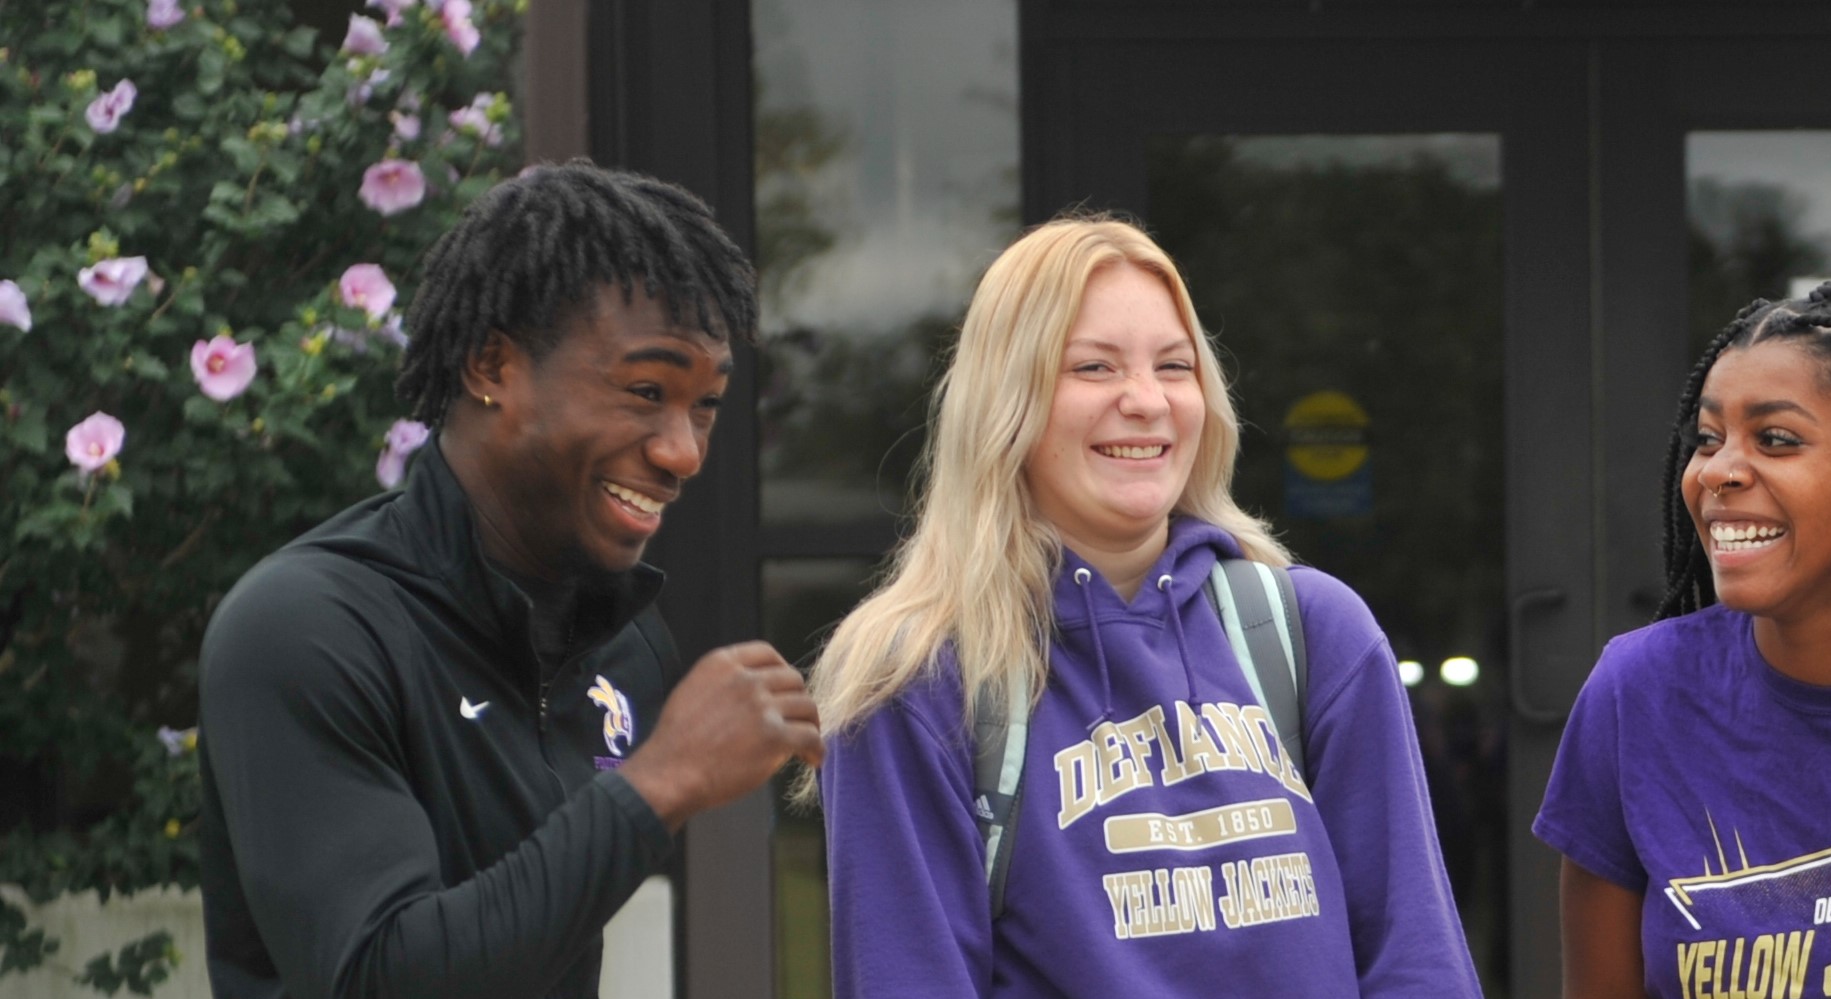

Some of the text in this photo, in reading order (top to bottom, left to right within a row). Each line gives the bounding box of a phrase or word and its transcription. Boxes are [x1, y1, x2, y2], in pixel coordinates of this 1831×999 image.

[1148, 806, 1274, 844] EST. 1850
[1103, 852, 1319, 940] YELLOW JACKETS
